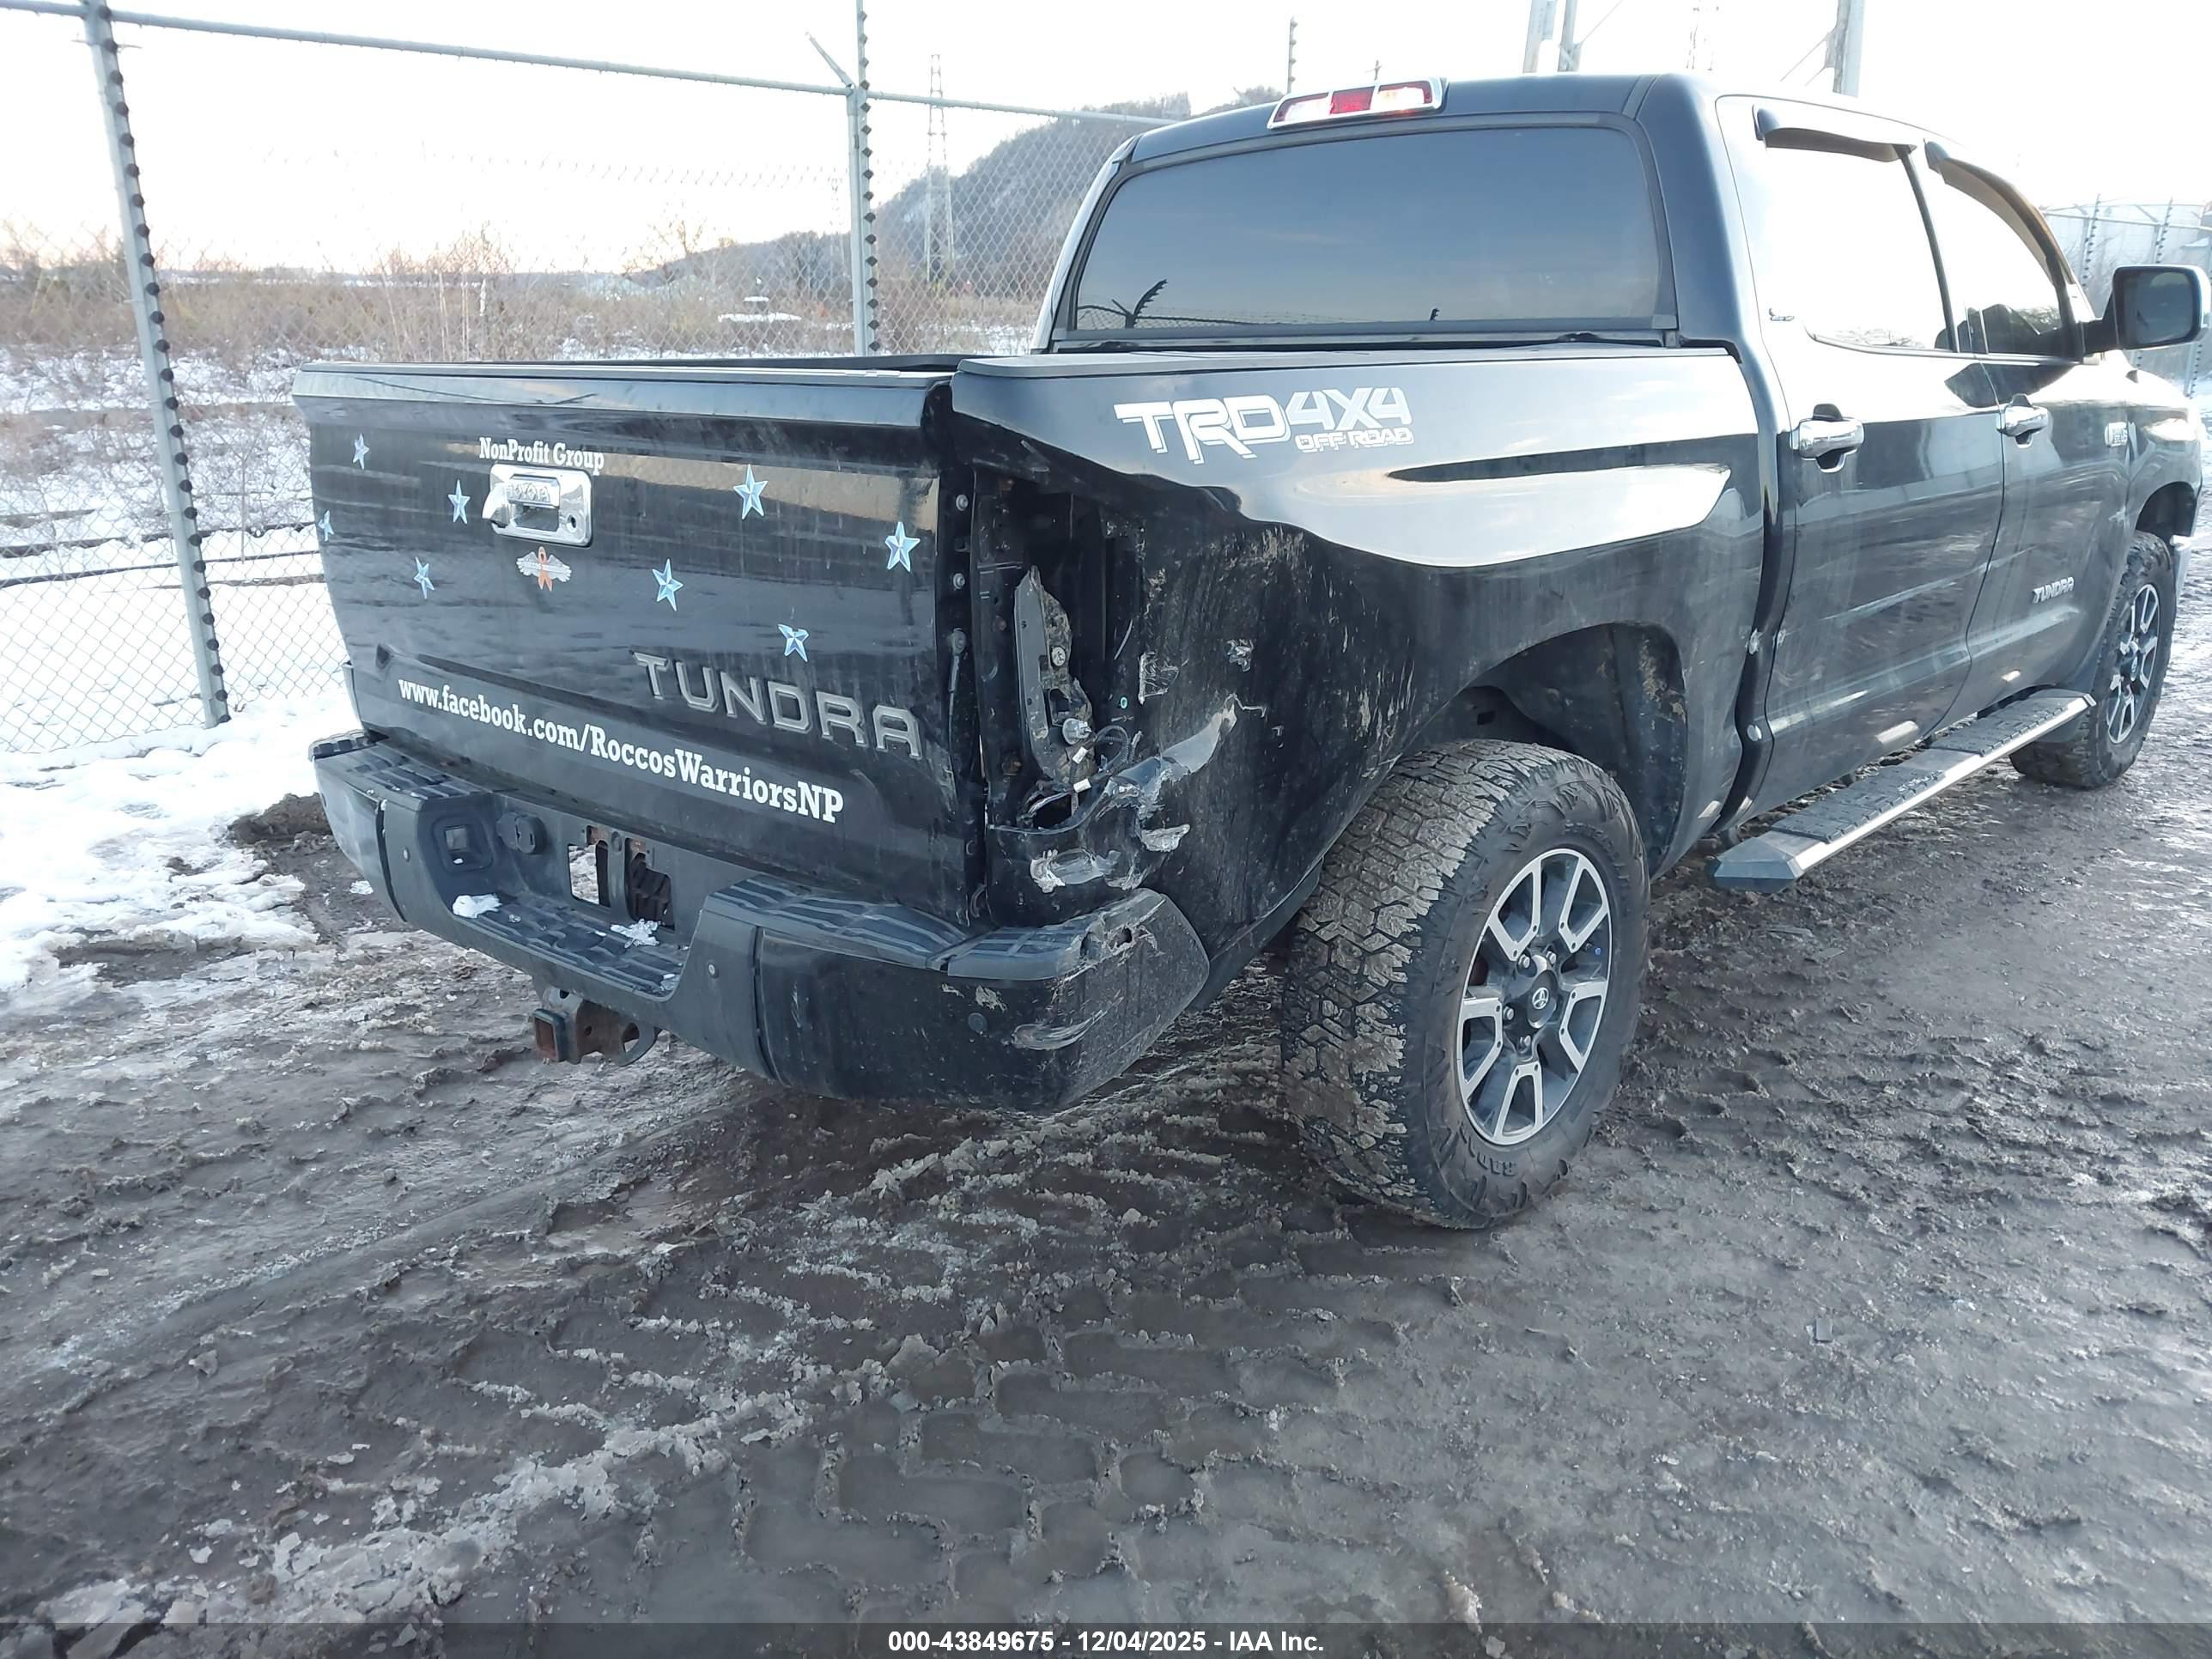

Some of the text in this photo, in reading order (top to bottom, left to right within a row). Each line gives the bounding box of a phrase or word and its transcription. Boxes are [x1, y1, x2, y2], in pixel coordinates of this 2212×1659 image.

[1113, 386, 1413, 465] TRD 4X4
[1294, 427, 1415, 453] OFF ROAD
[478, 436, 605, 477] NonProfit Group
[2032, 576, 2075, 604] TUNDRA
[633, 651, 923, 761] TUNDRA
[398, 678, 844, 823] www.facebook.com/RoccosWarriorsNP
